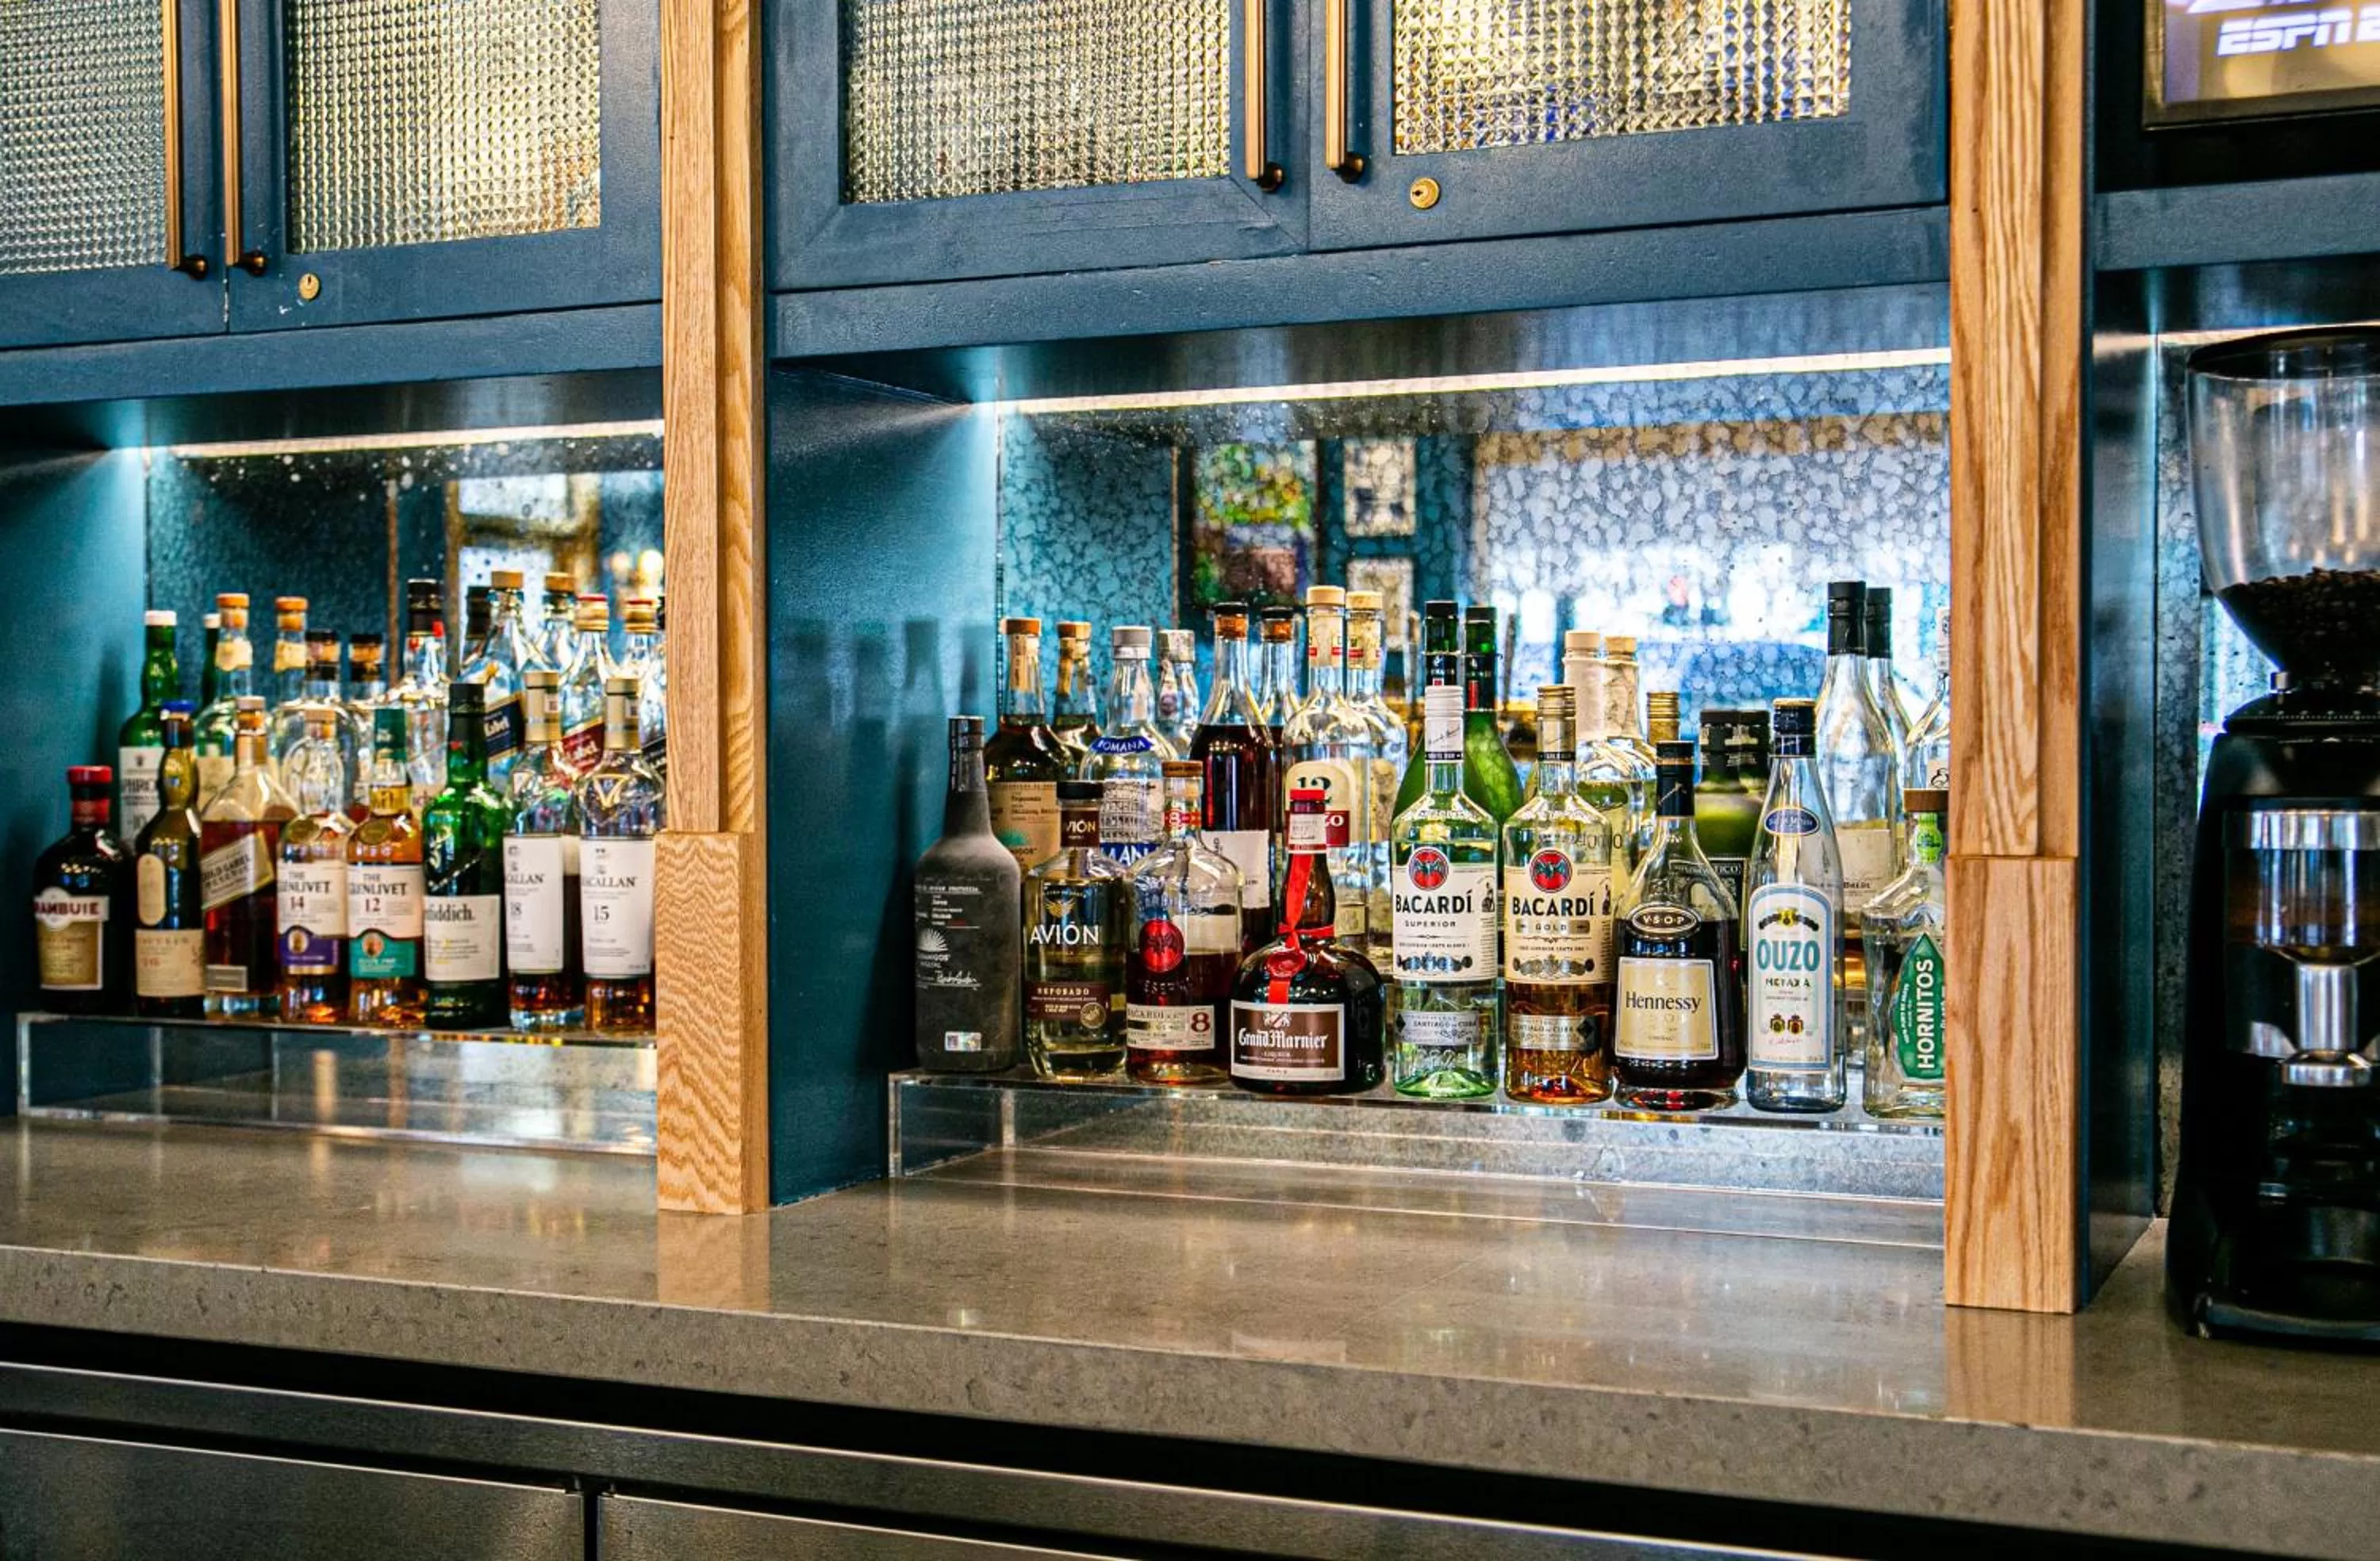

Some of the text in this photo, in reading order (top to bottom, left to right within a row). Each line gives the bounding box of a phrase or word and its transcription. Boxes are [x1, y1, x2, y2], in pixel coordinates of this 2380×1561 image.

[366, 898, 381, 912] 12
[593, 905, 610, 921] 15
[1395, 889, 1473, 914] BACARDÍ
[1512, 892, 1595, 916] BACARDÍ
[1029, 920, 1100, 945] AVIÓN
[1756, 938, 1821, 972] OUZO
[1625, 991, 1702, 1014] Hennessy
[1916, 958, 1935, 1070] HORNITOS
[1191, 1011, 1211, 1033] 8
[1238, 1027, 1329, 1049] Grand Marnier
